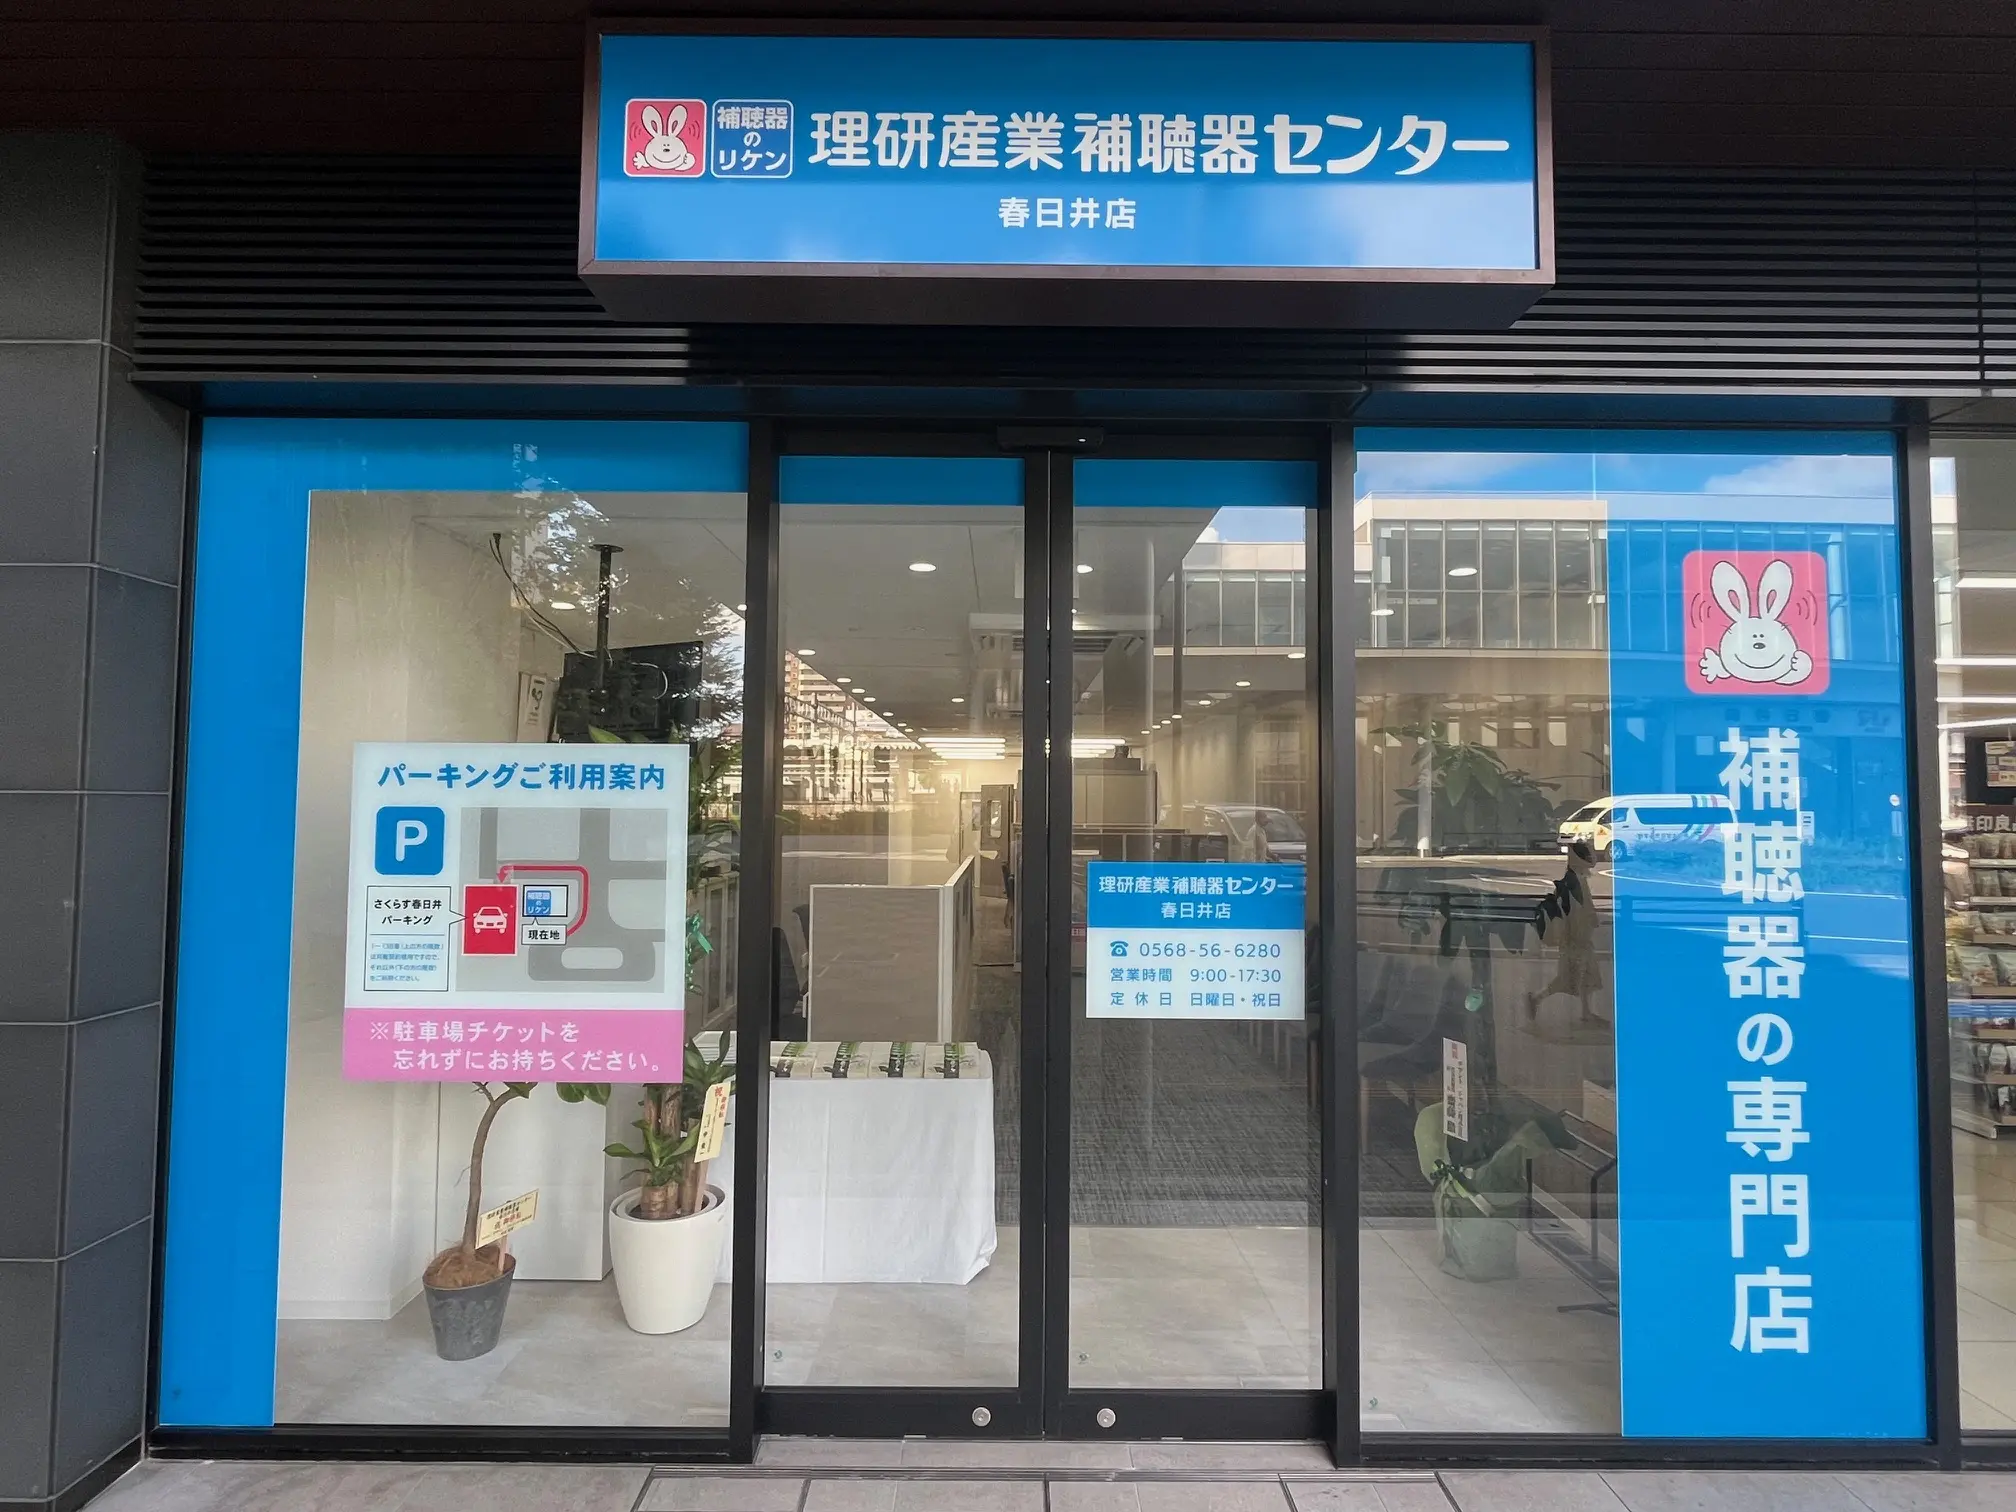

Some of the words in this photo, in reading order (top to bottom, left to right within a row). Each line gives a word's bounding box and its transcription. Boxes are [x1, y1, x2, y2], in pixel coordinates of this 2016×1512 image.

[718, 106, 788, 130] 補聴器
[743, 131, 762, 148] の
[809, 111, 1510, 177] 理研産業補聴器センター
[719, 149, 787, 171] リケン
[998, 196, 1137, 231] 春日井店
[377, 764, 665, 790] パーキングご利用案内
[1967, 814, 2016, 832] 印良
[395, 820, 428, 862] P
[1099, 876, 1294, 895] 理研産業補聴器センター
[374, 899, 442, 910] さくらす春日井
[1161, 902, 1231, 919] 春日井店
[528, 930, 560, 940] 現在地
[1139, 943, 1281, 958] 0568-56-6280
[1110, 968, 1173, 982] 営業時間
[1190, 969, 1282, 983] 9:00-17:30
[1190, 993, 1281, 1008] 日曜日・祝日
[370, 1021, 580, 1044] ※駐車場チケットを
[1717, 726, 1813, 1354] 補聴器の専門店
[393, 1049, 660, 1072] 忘れずにお持ちください。
